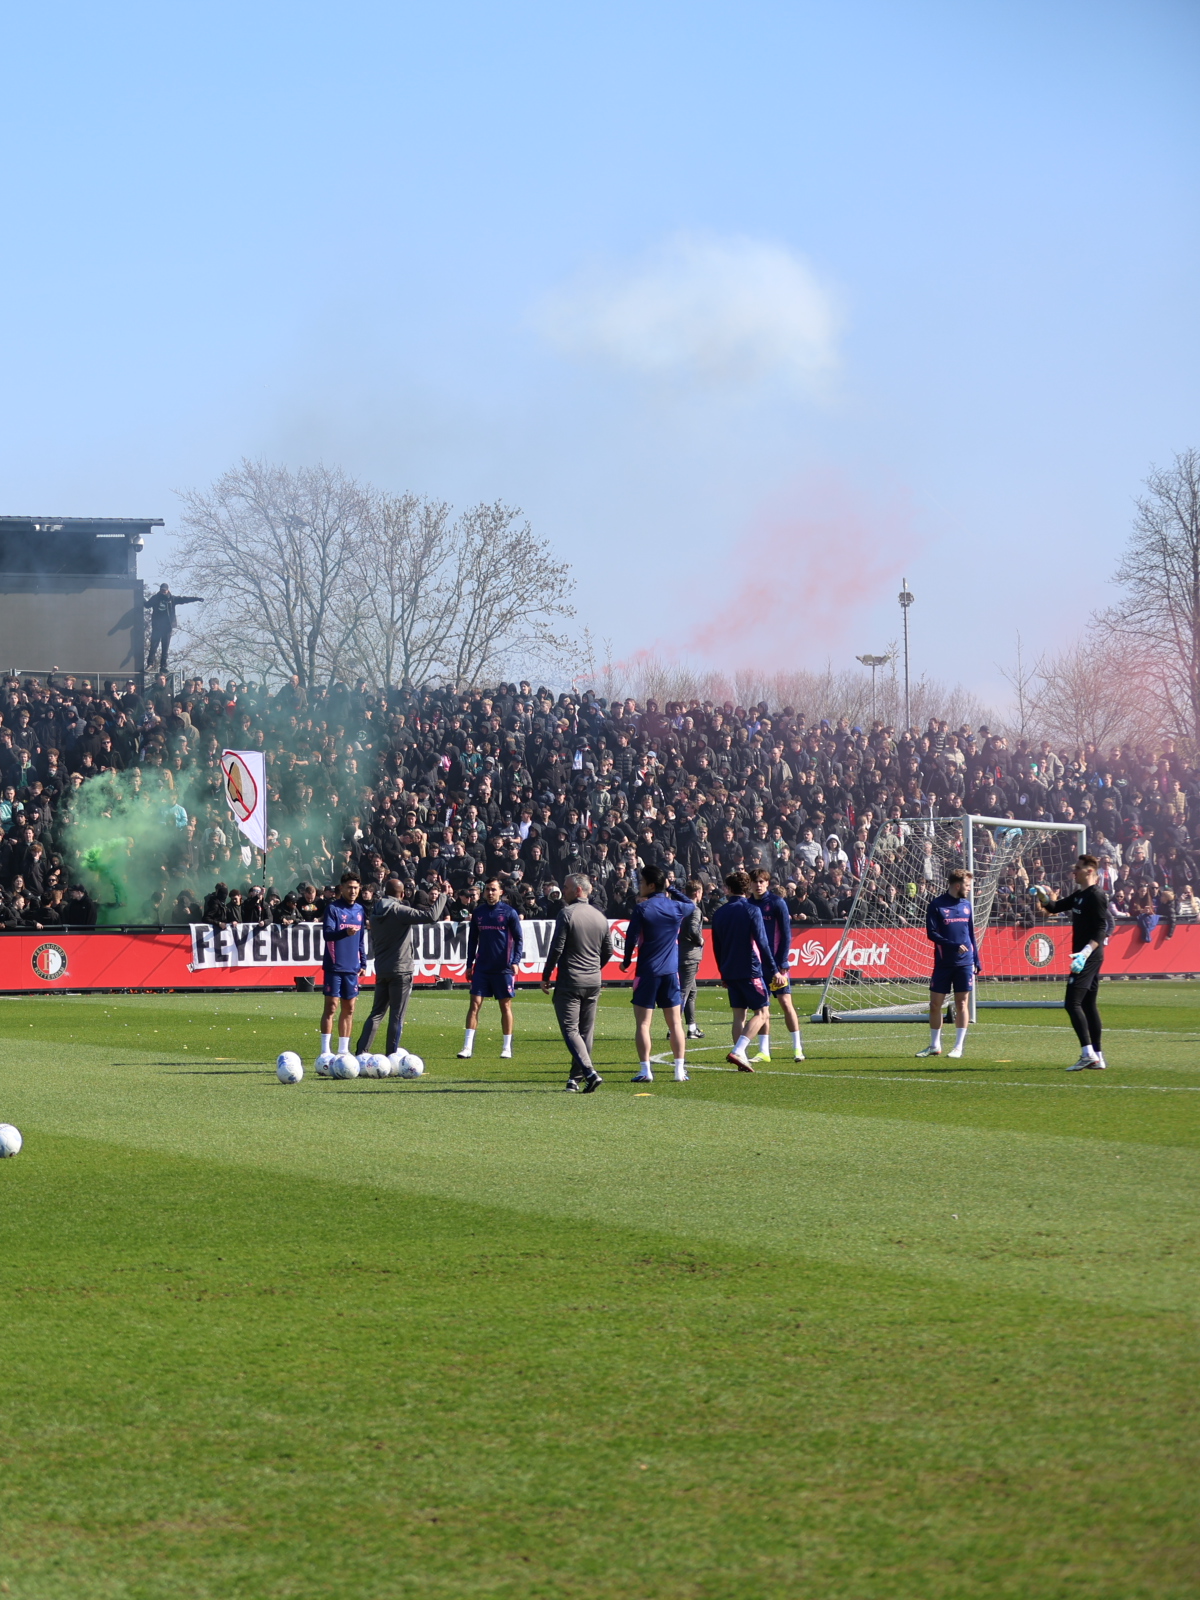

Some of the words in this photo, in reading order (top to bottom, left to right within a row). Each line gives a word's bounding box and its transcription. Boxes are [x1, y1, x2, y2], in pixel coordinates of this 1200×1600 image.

[195, 923, 376, 962] FEYENOO
[34, 943, 65, 957] FEYENOORD
[34, 966, 65, 980] ROTTERDAM
